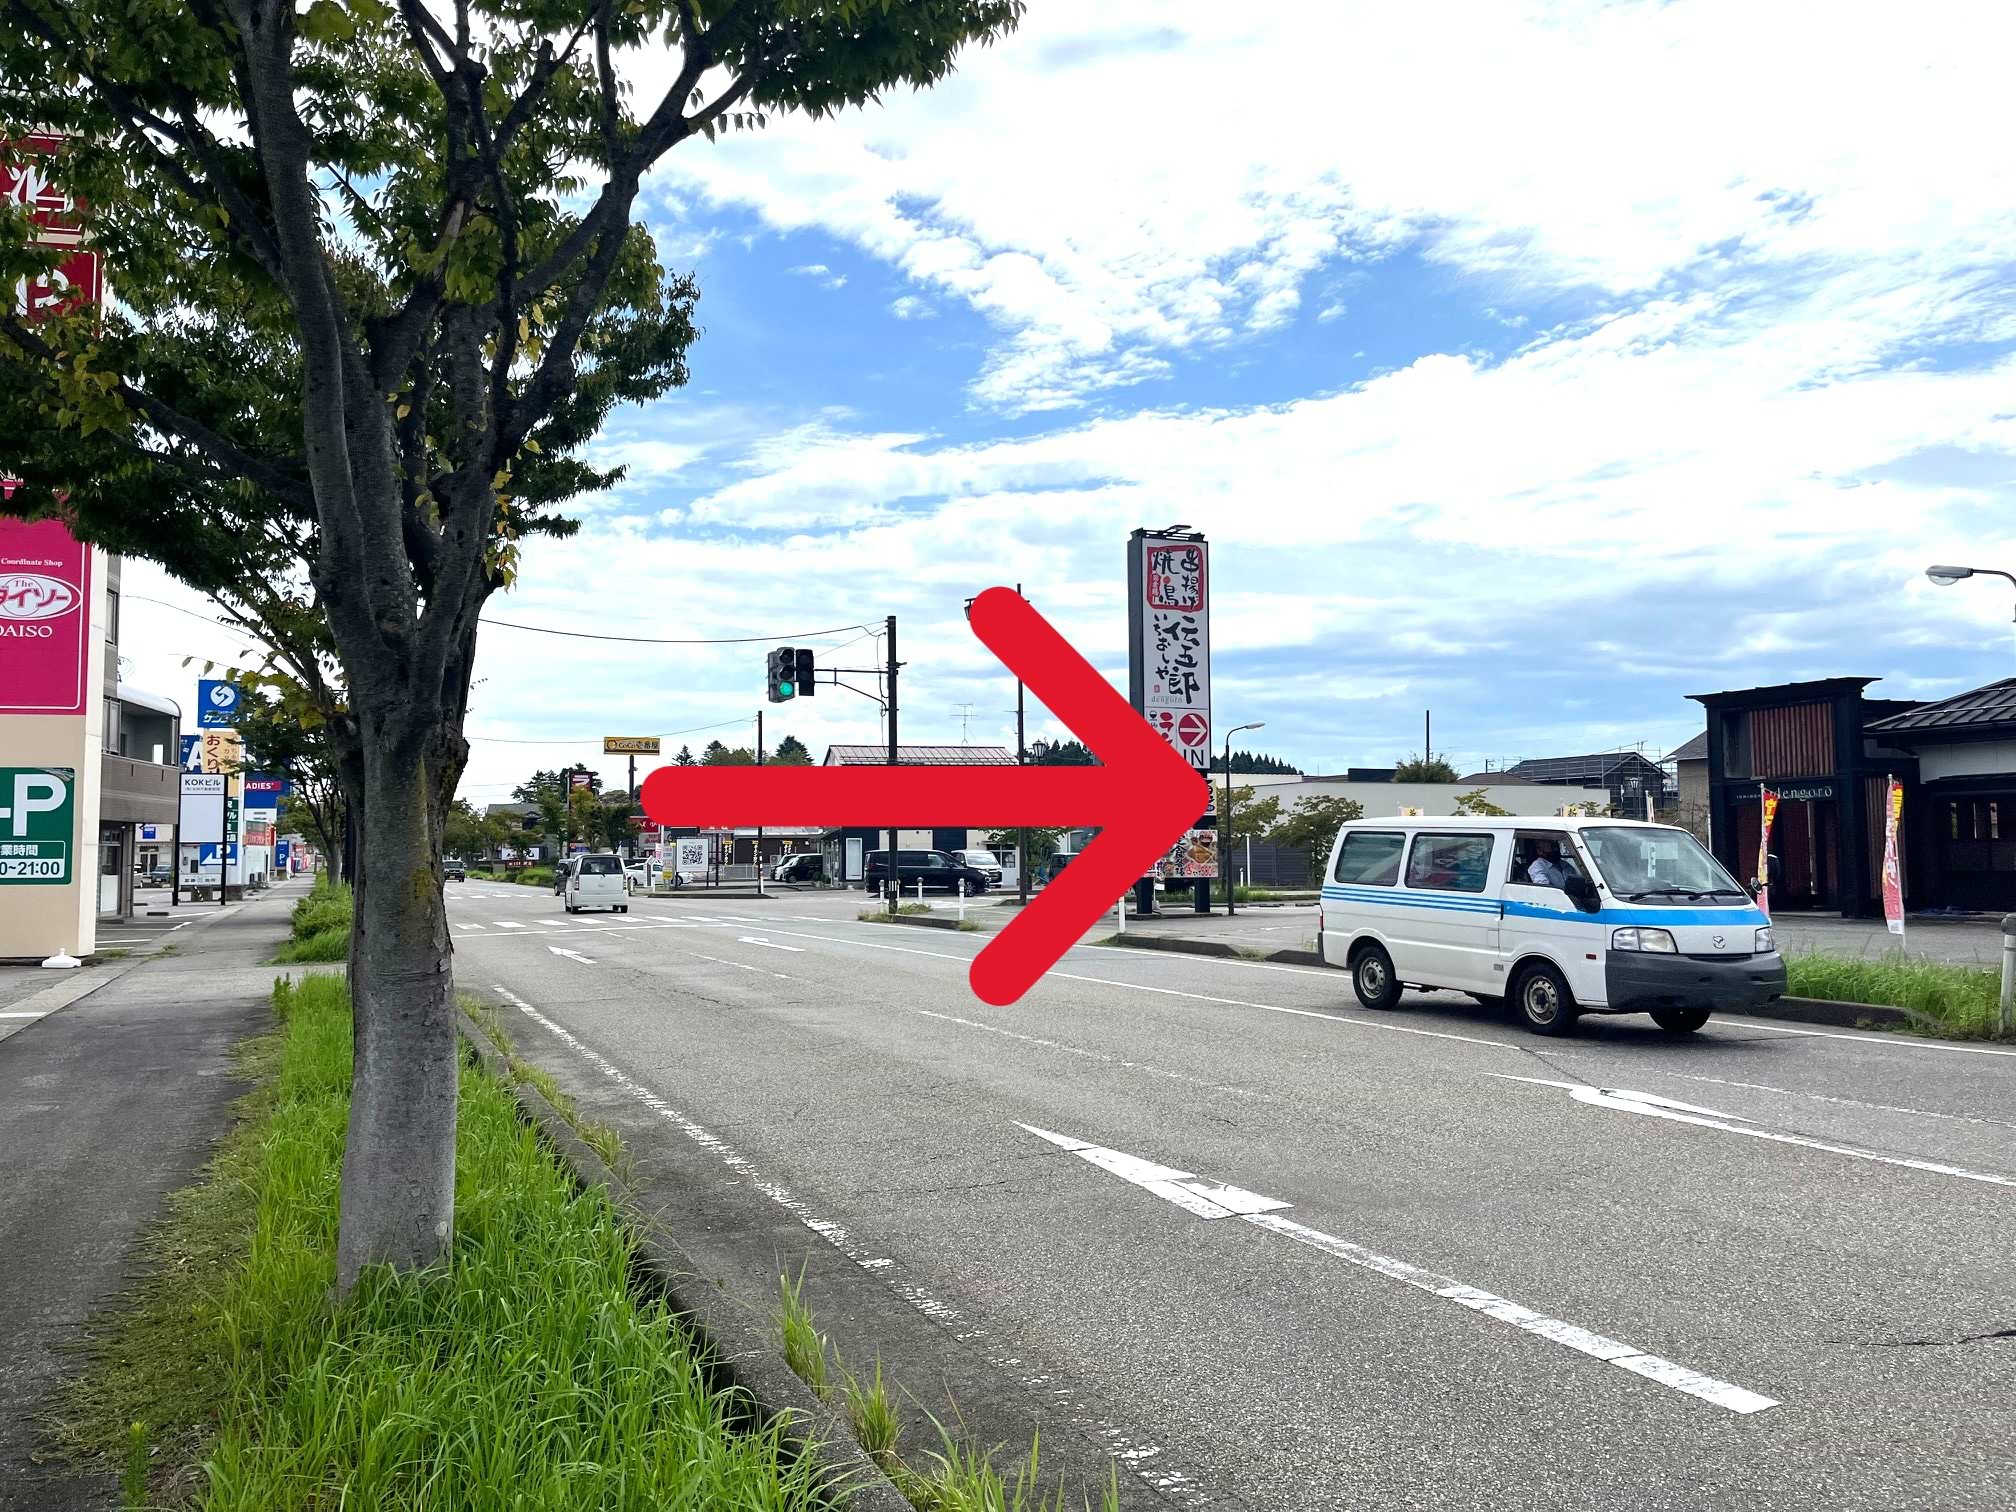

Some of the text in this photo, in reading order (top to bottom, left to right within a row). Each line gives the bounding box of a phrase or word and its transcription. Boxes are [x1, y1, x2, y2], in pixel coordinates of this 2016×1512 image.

[1, 557, 63, 567] Coordinate Shop
[14, 580, 34, 588] The
[1153, 613, 1171, 680] いちおしや
[1183, 748, 1205, 767] IN
[13, 773, 67, 836] P
[1, 844, 38, 856] 業時間
